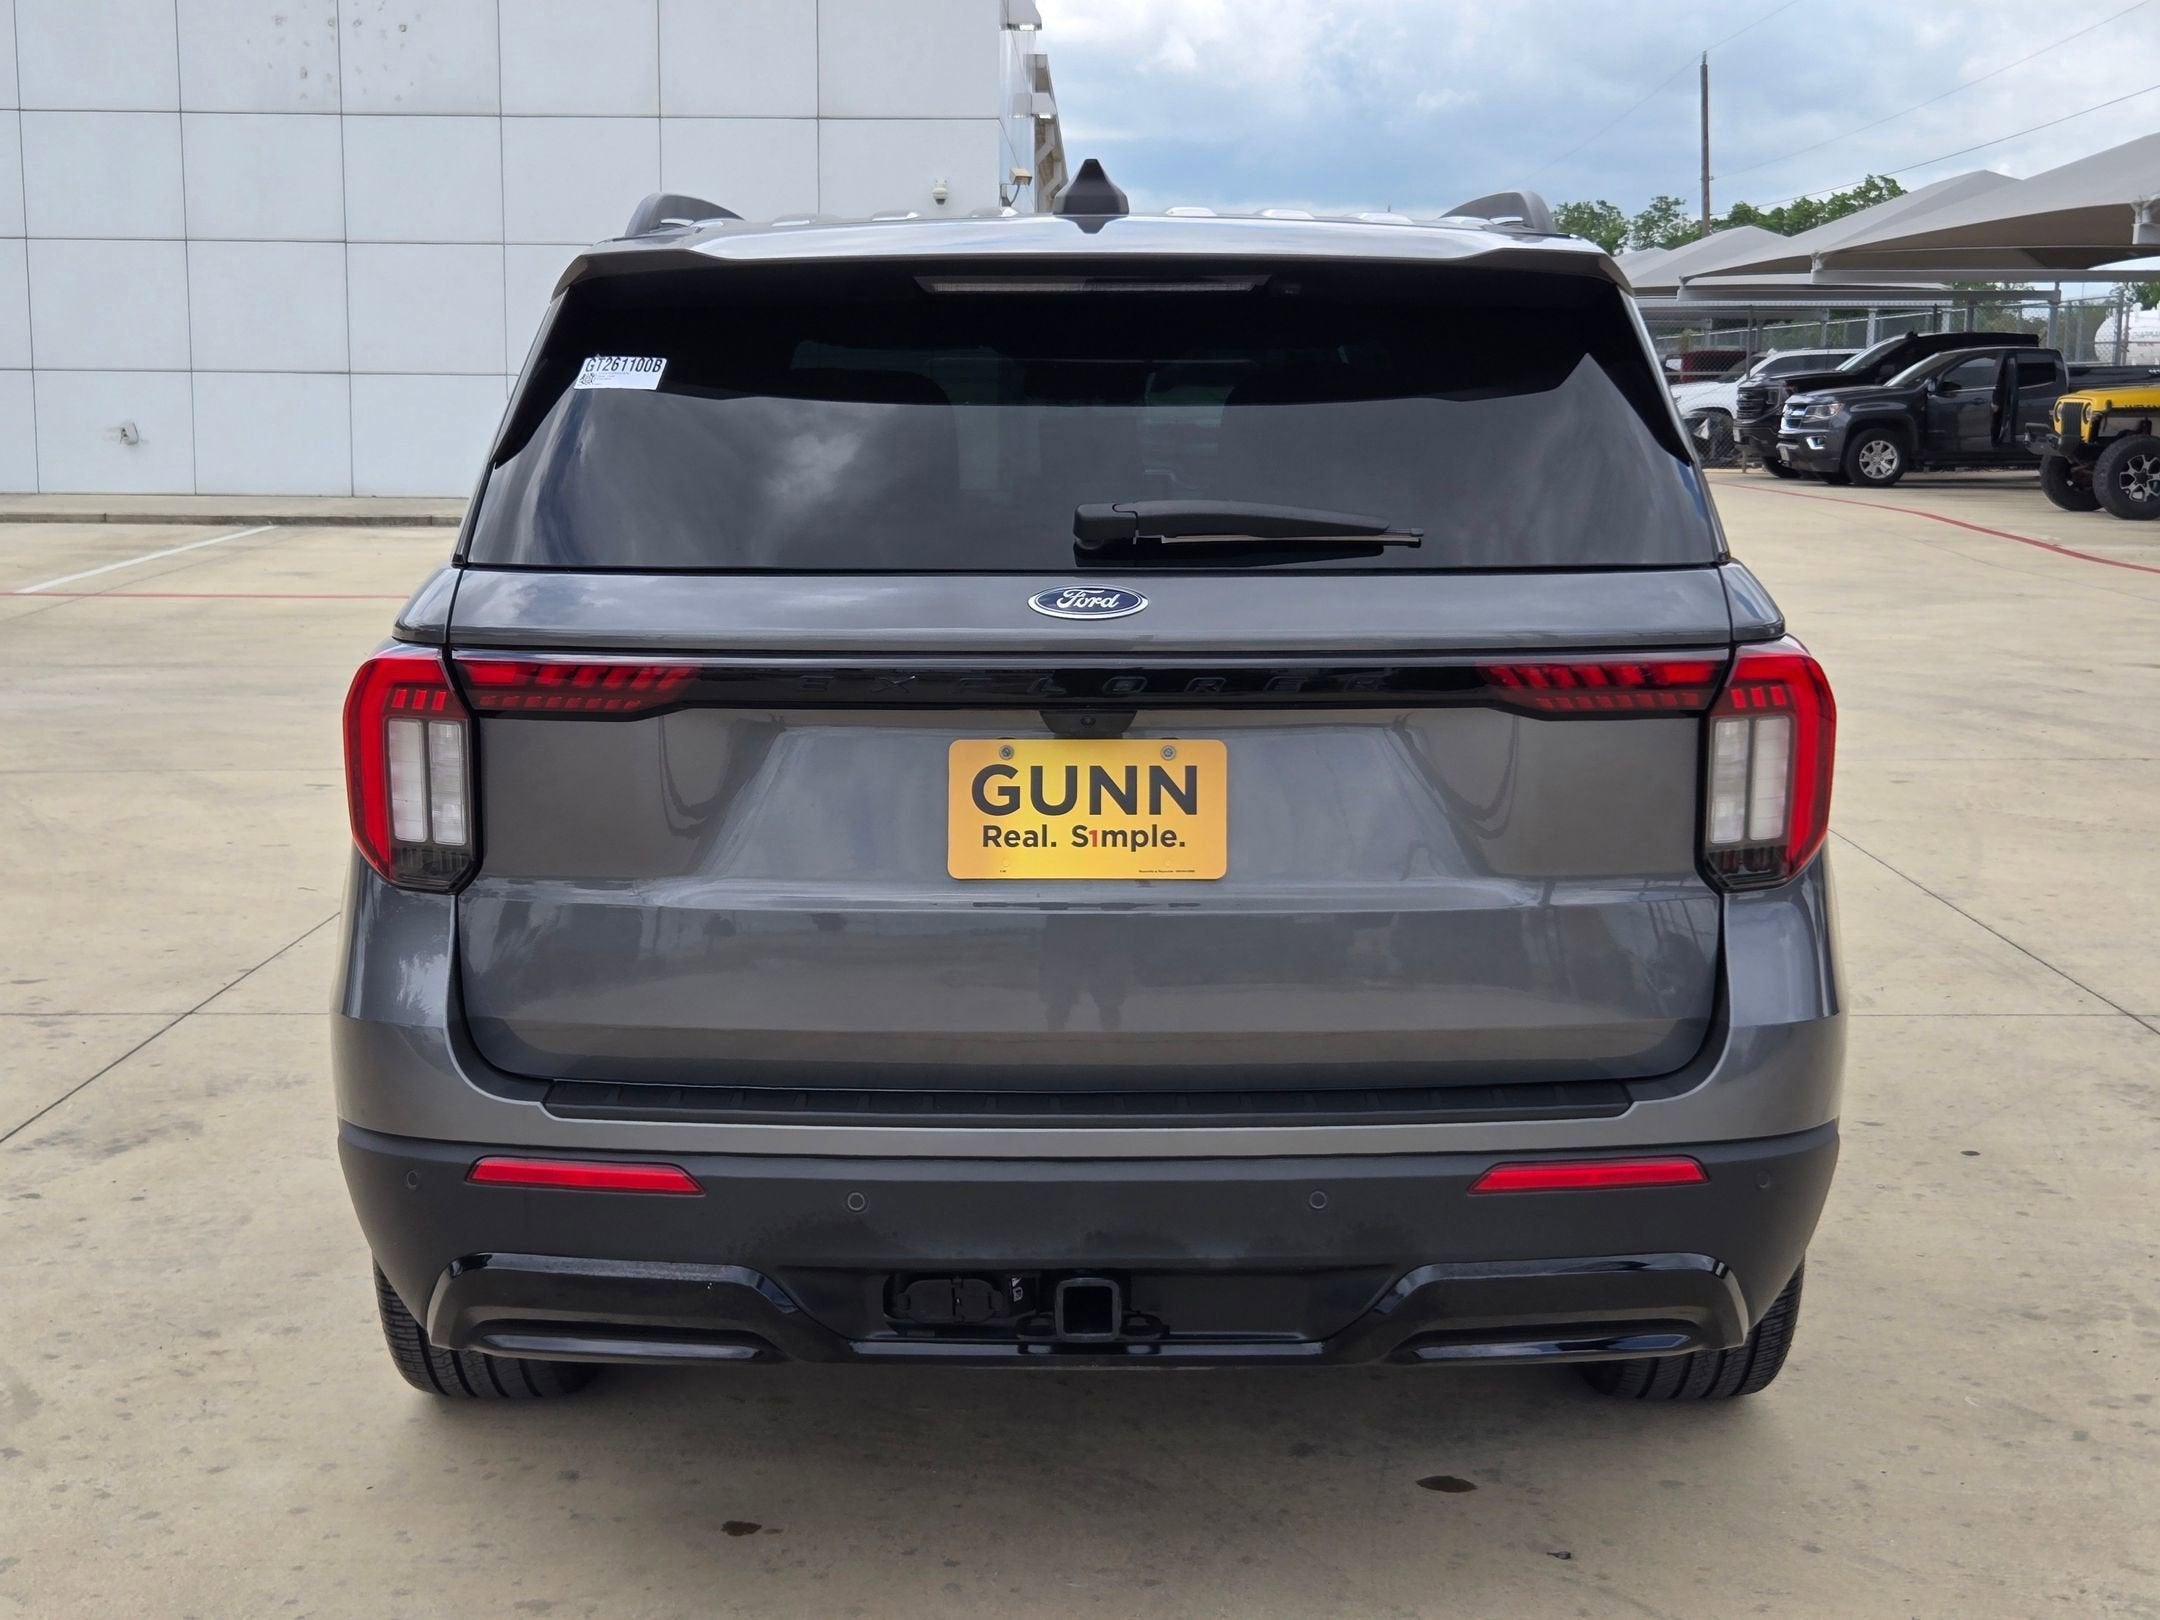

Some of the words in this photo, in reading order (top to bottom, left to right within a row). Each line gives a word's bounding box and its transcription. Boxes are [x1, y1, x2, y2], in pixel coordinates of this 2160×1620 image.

[1056, 588, 1120, 608] Ford
[971, 763, 1198, 817] GUNN
[982, 824, 1057, 848] Real.
